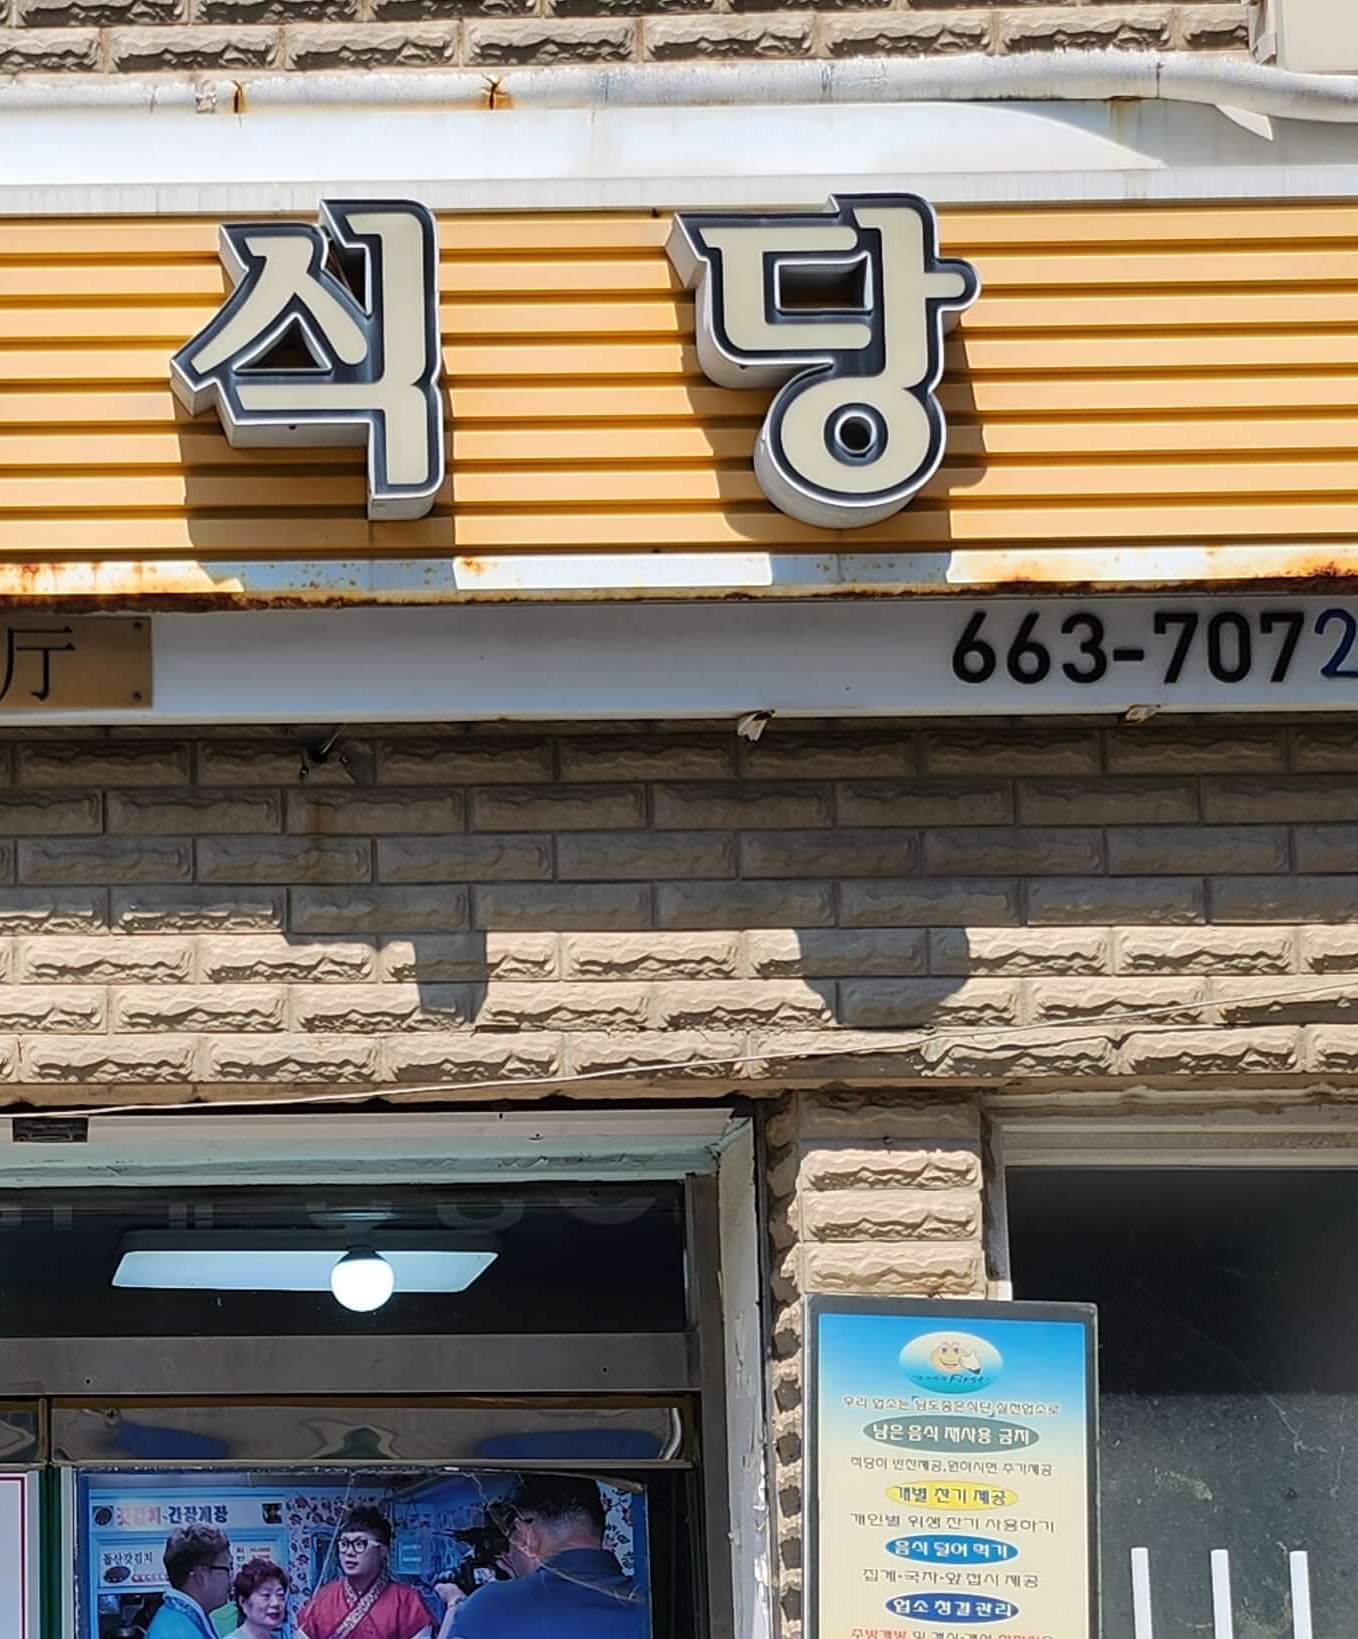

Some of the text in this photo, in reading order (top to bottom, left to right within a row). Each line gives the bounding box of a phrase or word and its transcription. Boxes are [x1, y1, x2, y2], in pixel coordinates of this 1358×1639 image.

[951, 608, 1358, 685] 663-7072
[872, 1424, 1030, 1446] 남은 음식 재사용 금지
[895, 1540, 928, 1556] 음식
